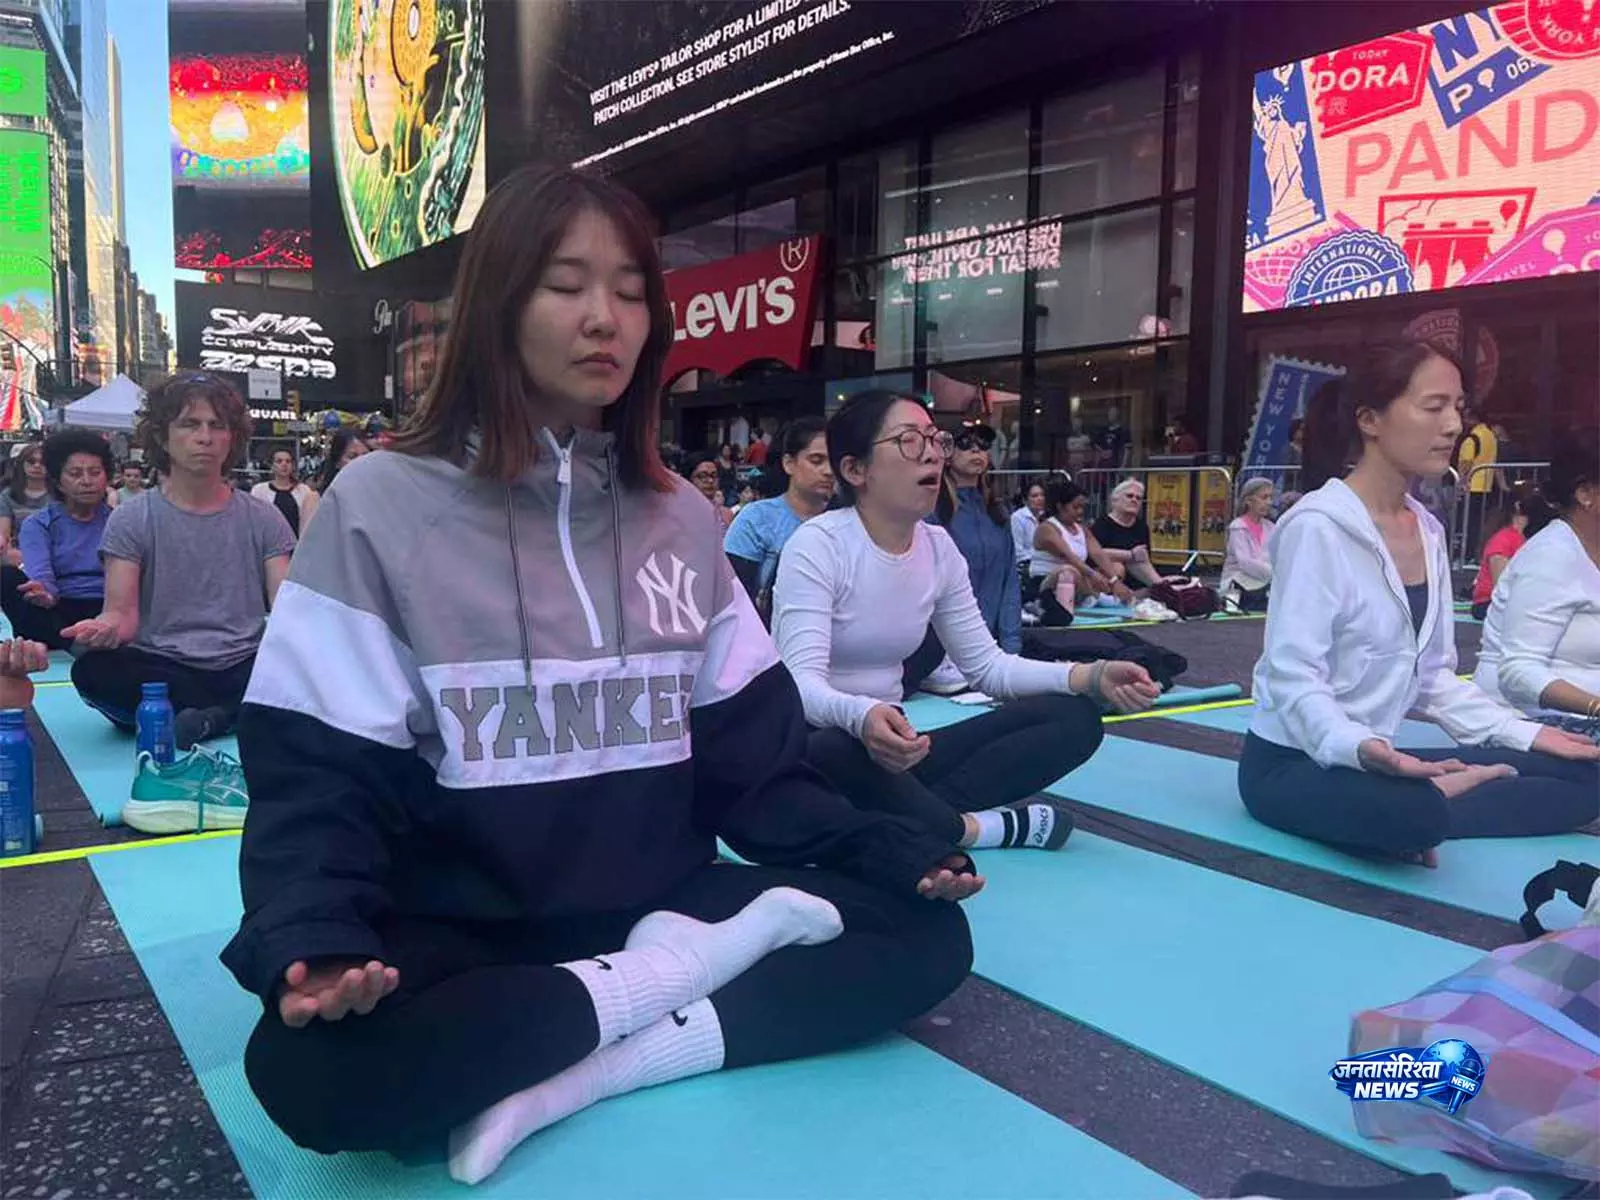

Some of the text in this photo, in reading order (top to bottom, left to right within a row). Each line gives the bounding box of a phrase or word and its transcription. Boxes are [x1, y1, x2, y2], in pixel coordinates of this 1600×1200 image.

[590, 84, 609, 105] VISIT
[610, 76, 627, 96] THE
[660, 44, 692, 72] TAILOR
[694, 30, 720, 56] SHOP
[722, 19, 743, 42] FOR
[745, 14, 753, 31] A
[593, 102, 619, 126] PATCH
[676, 66, 694, 88] SEE
[695, 51, 727, 79] STORE
[728, 31, 770, 64] STYLIST
[772, 19, 795, 44] FOR
[797, 0, 850, 33] DETAILS.
[1505, 57, 1537, 80] 06
[1345, 89, 1599, 200] PAND
[1301, 243, 1388, 286] INTERNATIONAL
[201, 335, 335, 356] COMPLEXITY
[1268, 371, 1292, 417] NEW
[636, 552, 707, 636] NY
